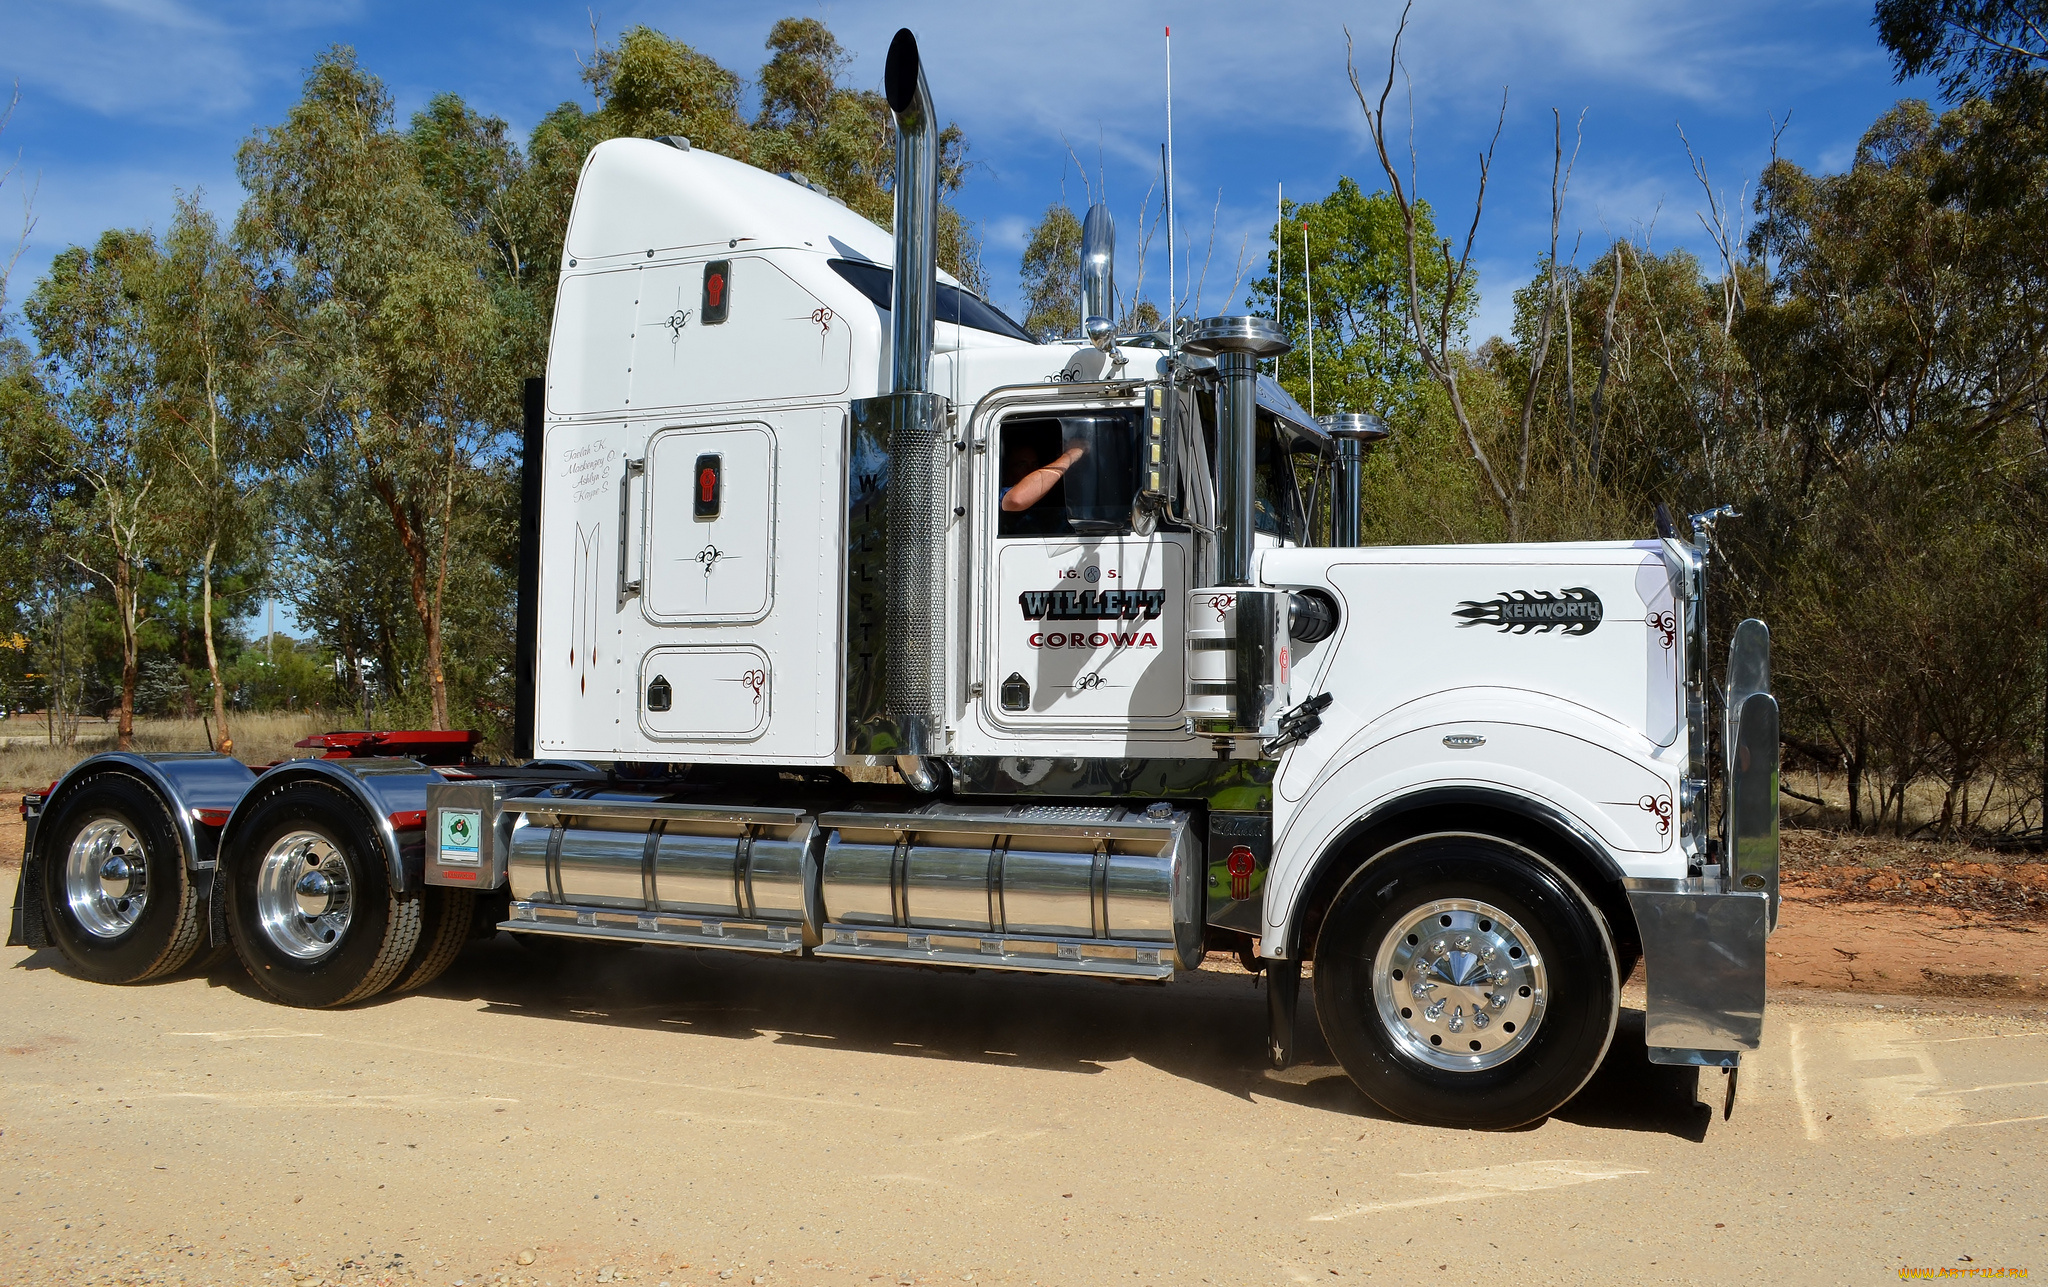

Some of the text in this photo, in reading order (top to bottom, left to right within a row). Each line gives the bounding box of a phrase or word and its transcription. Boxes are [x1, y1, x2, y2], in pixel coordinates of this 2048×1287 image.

[859, 474, 877, 671] WILLETT
[1058, 570, 1080, 579] I.G.
[1107, 569, 1121, 579] S.
[1020, 590, 1165, 619] WILLETT
[1502, 602, 1599, 617] KENWORTH
[1028, 632, 1157, 648] COROWA
